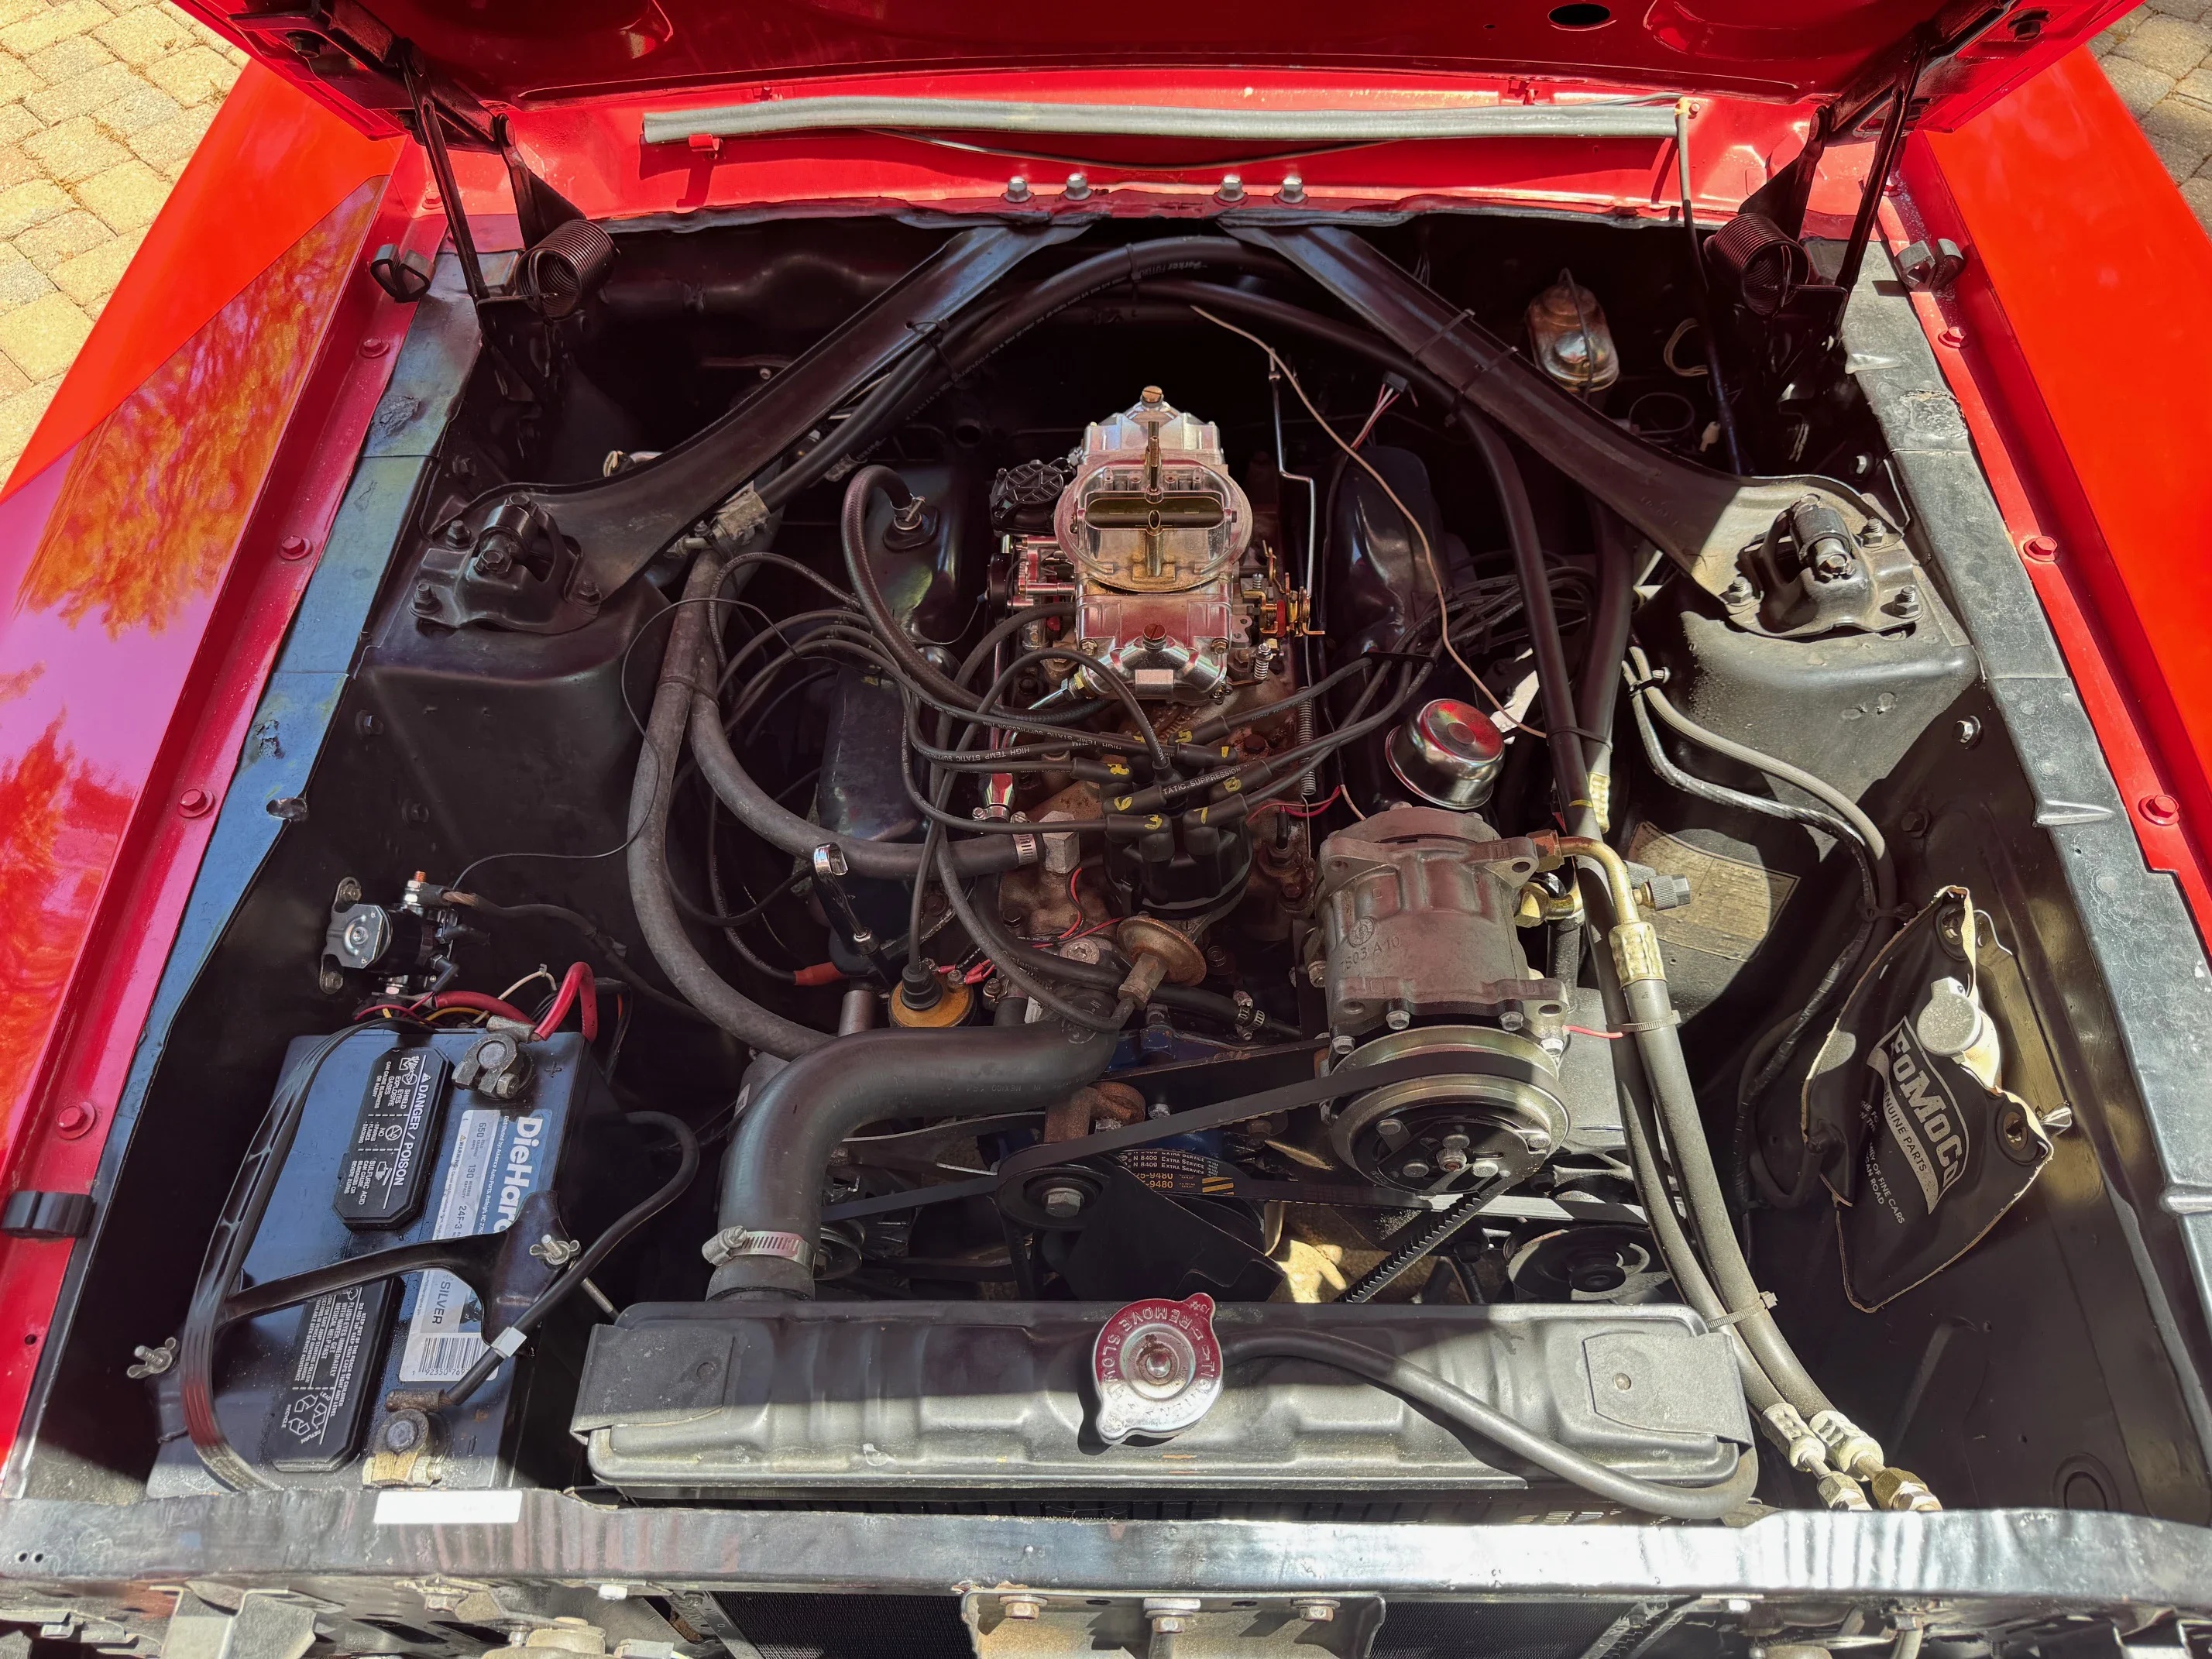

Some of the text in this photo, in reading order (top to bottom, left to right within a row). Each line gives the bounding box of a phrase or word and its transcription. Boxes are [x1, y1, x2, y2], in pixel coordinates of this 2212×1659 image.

[984, 750, 1006, 760] TEMP
[1009, 746, 1030, 755] HIGH
[1162, 767, 1241, 795] TATIC. SUPPRESSION
[383, 1074, 395, 1096] GASES
[387, 1074, 401, 1108] EXPLOSIVE
[394, 1088, 404, 1105] EYES
[399, 1087, 410, 1110] SHIELD
[407, 1083, 429, 1132] DANGER
[377, 1126, 386, 1137] NO
[476, 1121, 486, 1139] 650
[392, 1139, 414, 1187] POISON
[492, 1148, 502, 1169] Advance
[1902, 1135, 1928, 1172] PARTS
[465, 1163, 476, 1180] 130
[358, 1159, 376, 1206] SULFURIC ACID
[1869, 1177, 1885, 1204] ROAD
[1870, 1162, 1882, 1176] OF
[1877, 1176, 1891, 1197] FINE
[1887, 1197, 1906, 1224] CARS
[453, 1203, 467, 1231] 24F-3
[479, 1214, 486, 1223] NC
[476, 1221, 485, 1236] 2760
[431, 1280, 452, 1325] SILVER
[319, 1315, 328, 1328] SAFE
[328, 1300, 348, 1354] WITH WATER. GET
[358, 1311, 366, 1326] KEEP
[1119, 1307, 1193, 1332] REMOVE
[320, 1301, 342, 1359] MEDICAL HELP FAST
[328, 1301, 355, 1377] FLUSH EYES IMMEDIATELY
[341, 1358, 349, 1373] CAPS
[346, 1355, 356, 1372] REACH
[344, 1372, 351, 1380] OF
[318, 1390, 331, 1401] LEAD
[329, 1400, 338, 1418] LEVEL
